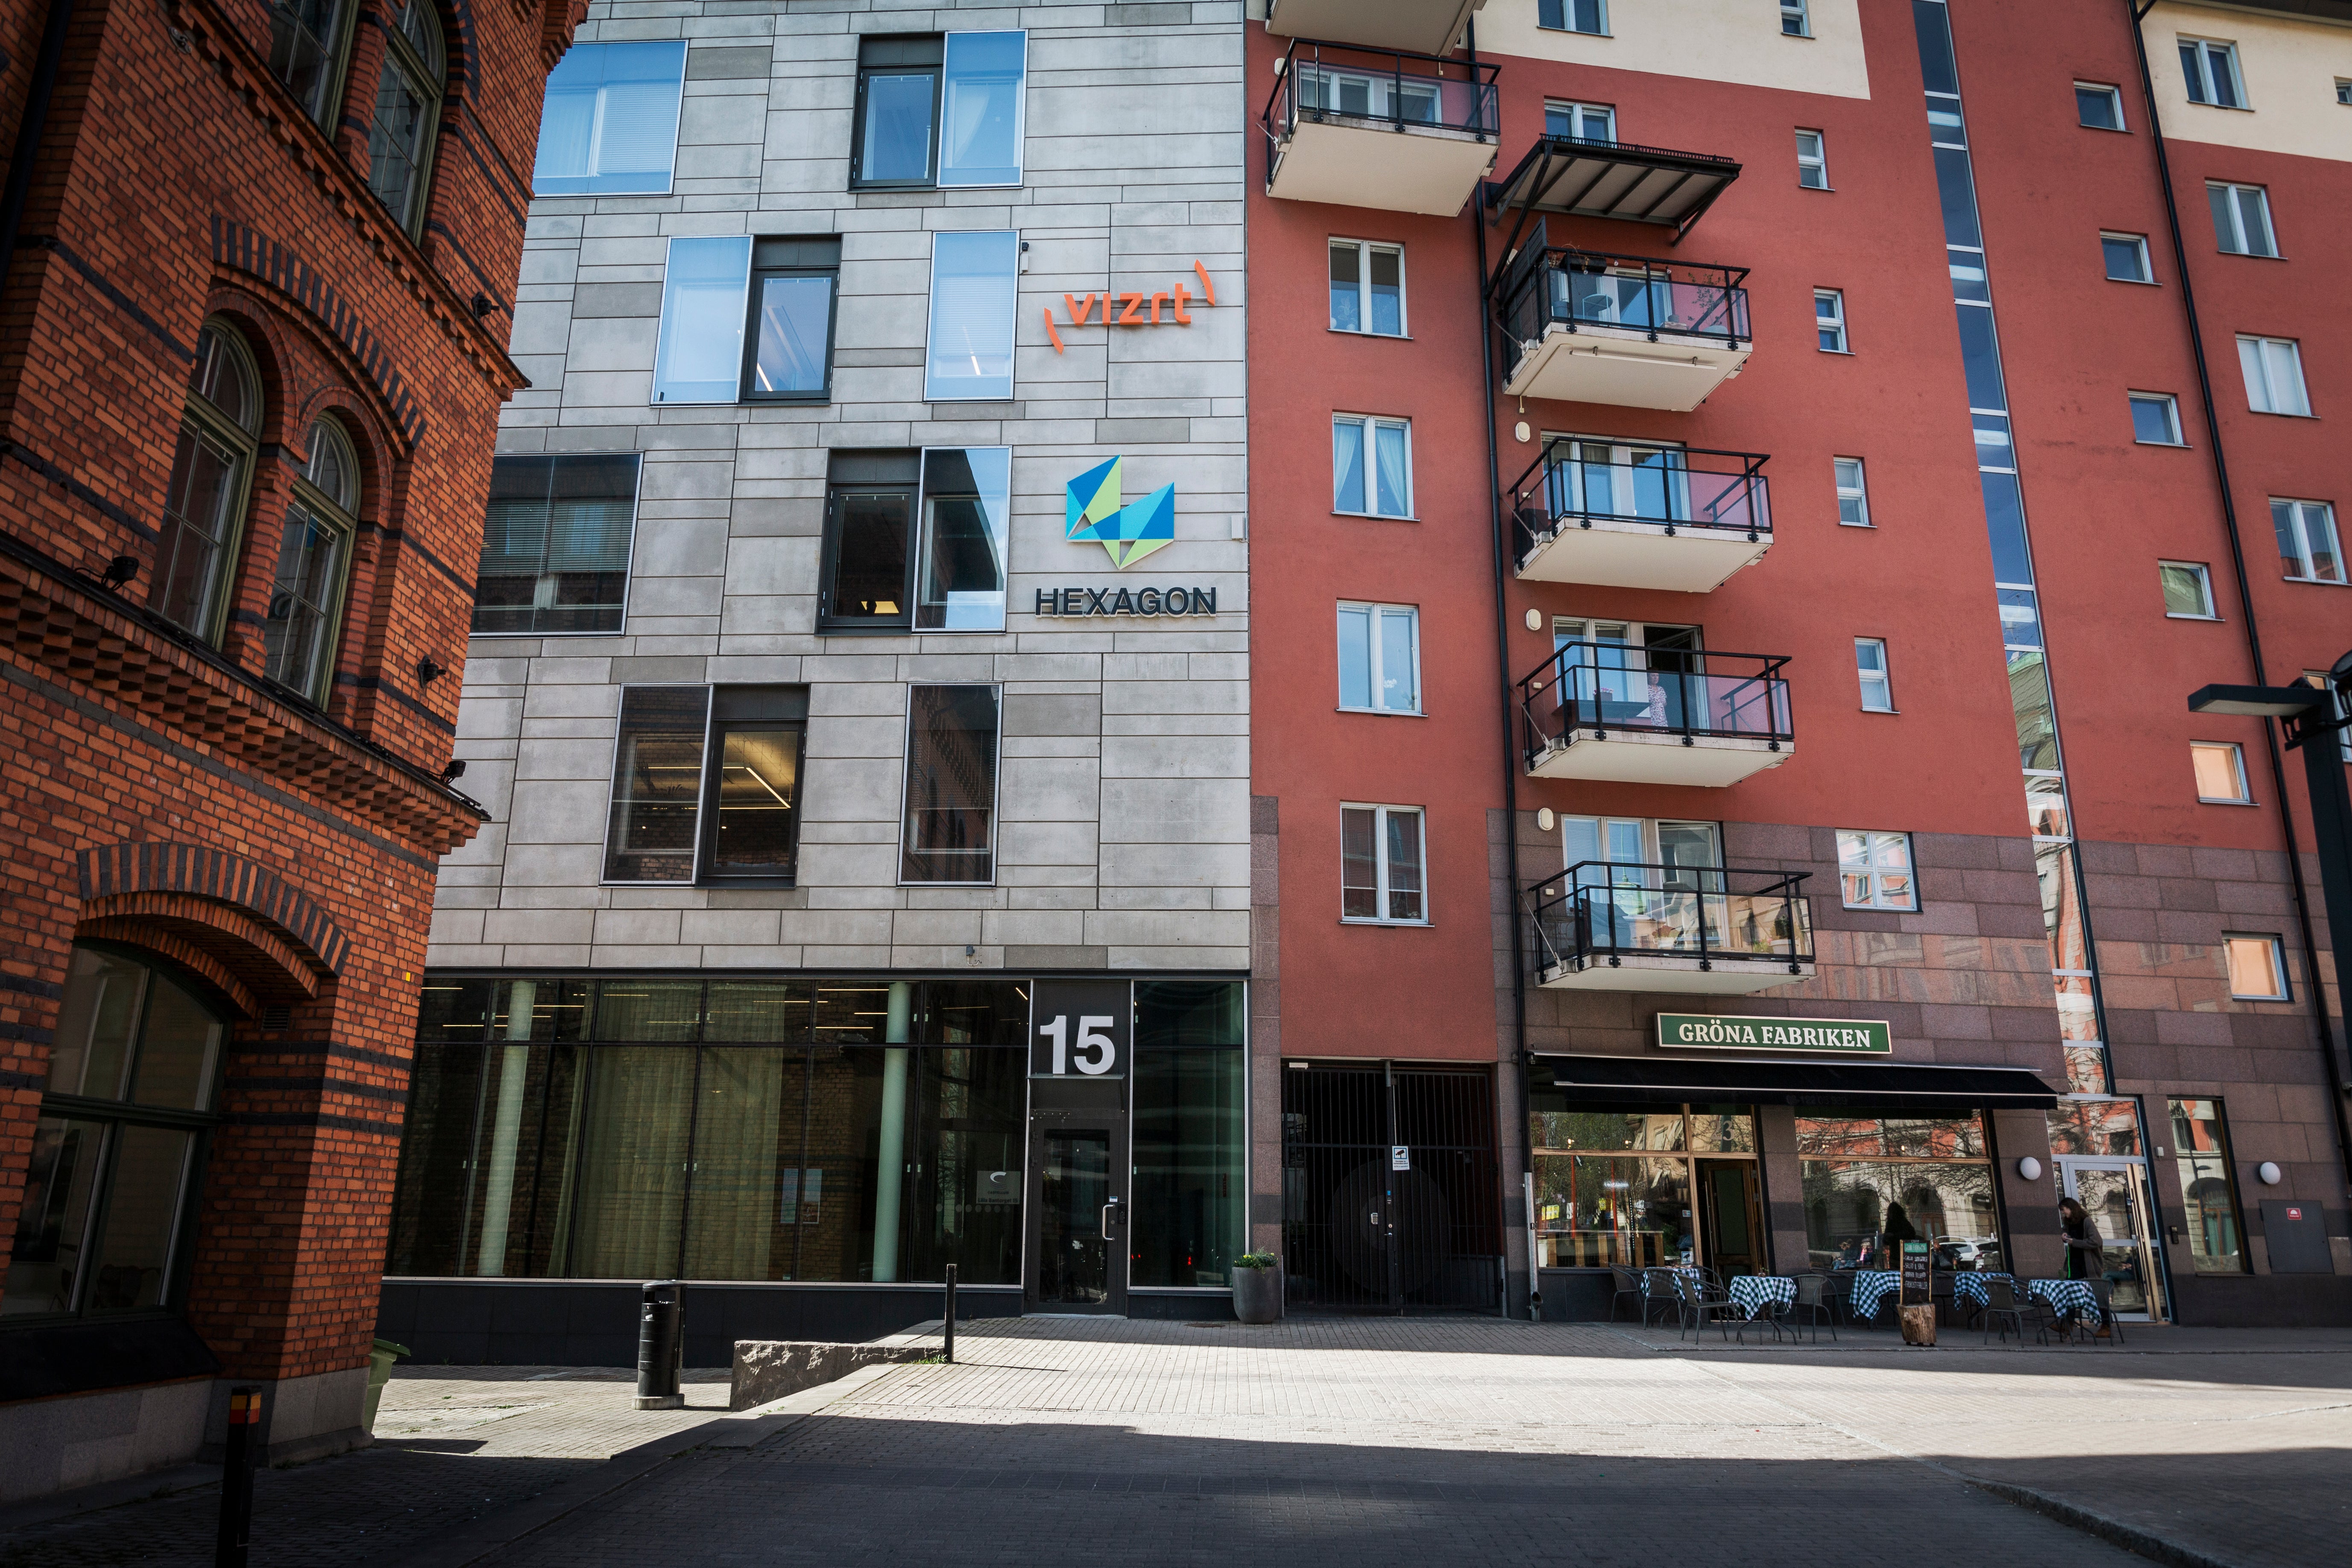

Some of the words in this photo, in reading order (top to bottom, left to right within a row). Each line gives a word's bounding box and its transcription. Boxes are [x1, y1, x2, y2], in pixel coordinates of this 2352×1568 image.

[1064, 283, 1191, 326] vizrt
[1035, 586, 1217, 617] HEXAGON
[1040, 1015, 1115, 1075] 15
[1679, 1019, 1757, 1044] GRÖNA
[1761, 1026, 1870, 1048] FABRIKEN
[1709, 1120, 1734, 1141] 23
